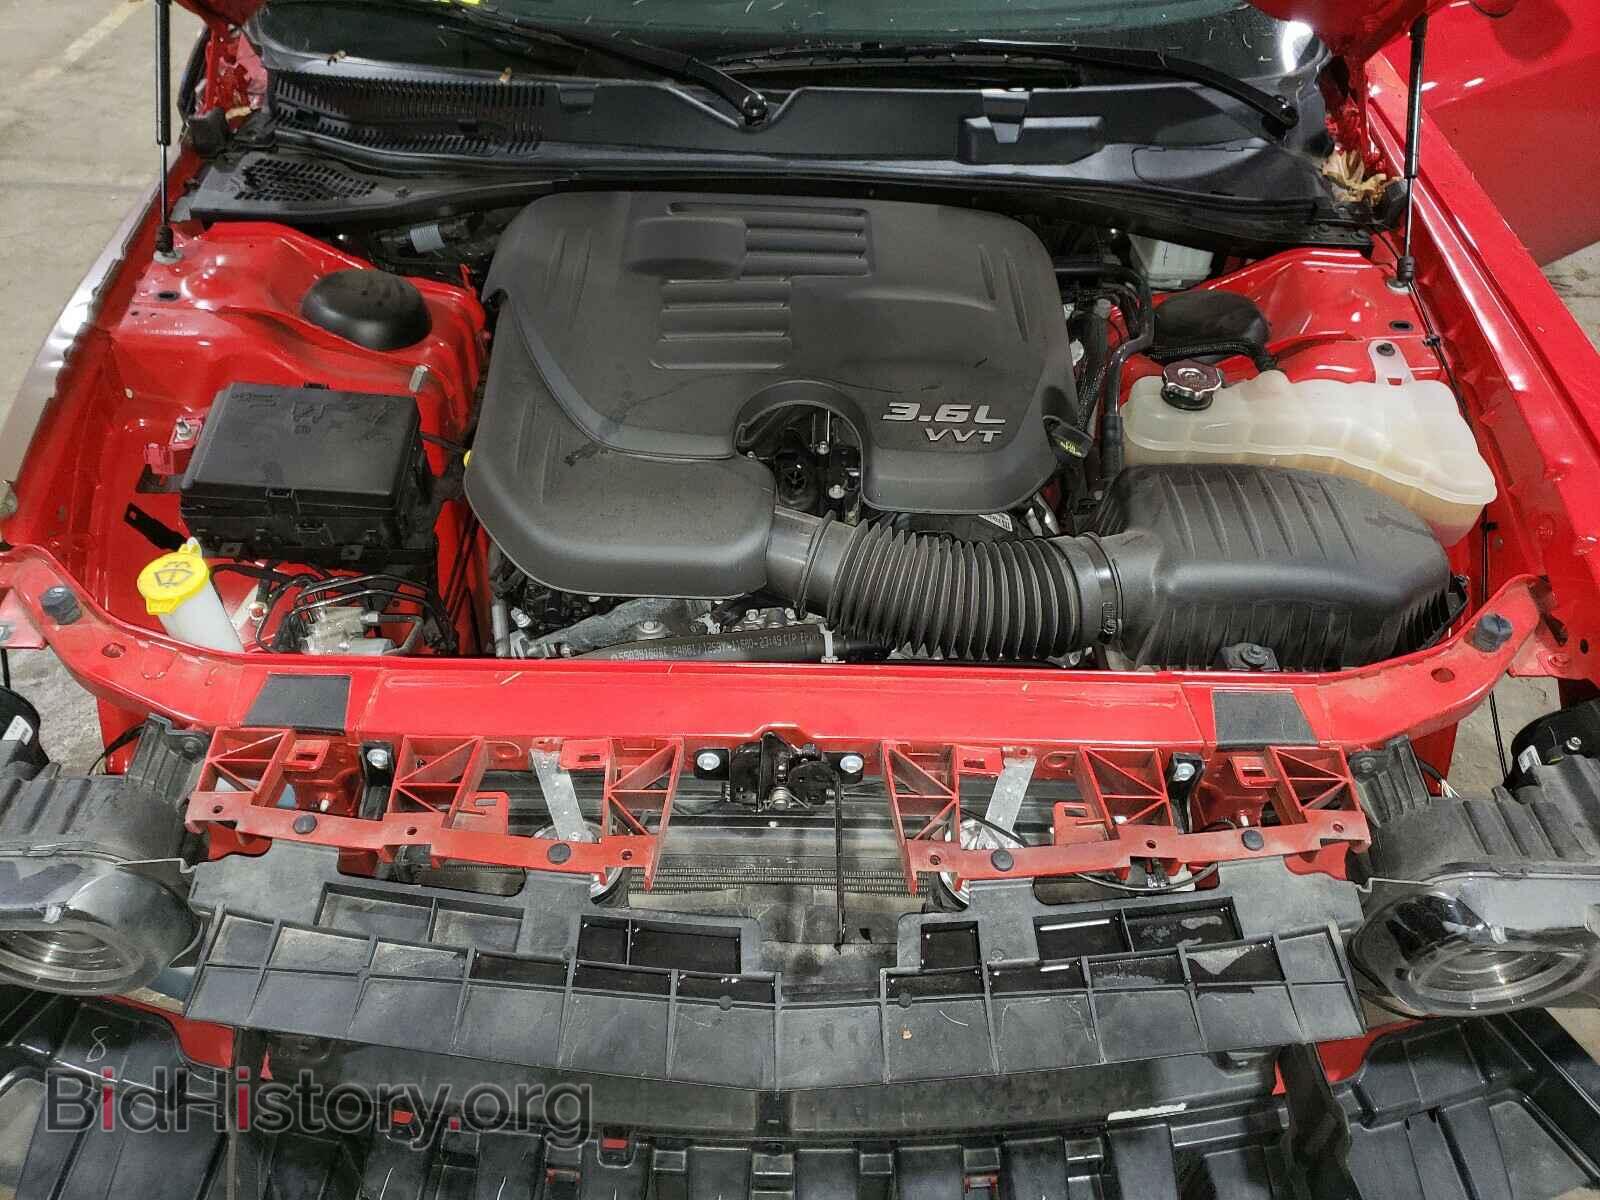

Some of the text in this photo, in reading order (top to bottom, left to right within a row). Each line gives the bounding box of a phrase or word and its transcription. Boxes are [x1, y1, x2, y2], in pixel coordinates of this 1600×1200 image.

[882, 401, 1006, 424] 3.6L
[924, 427, 1002, 443] VVT
[86, 1025, 108, 1062] 8
